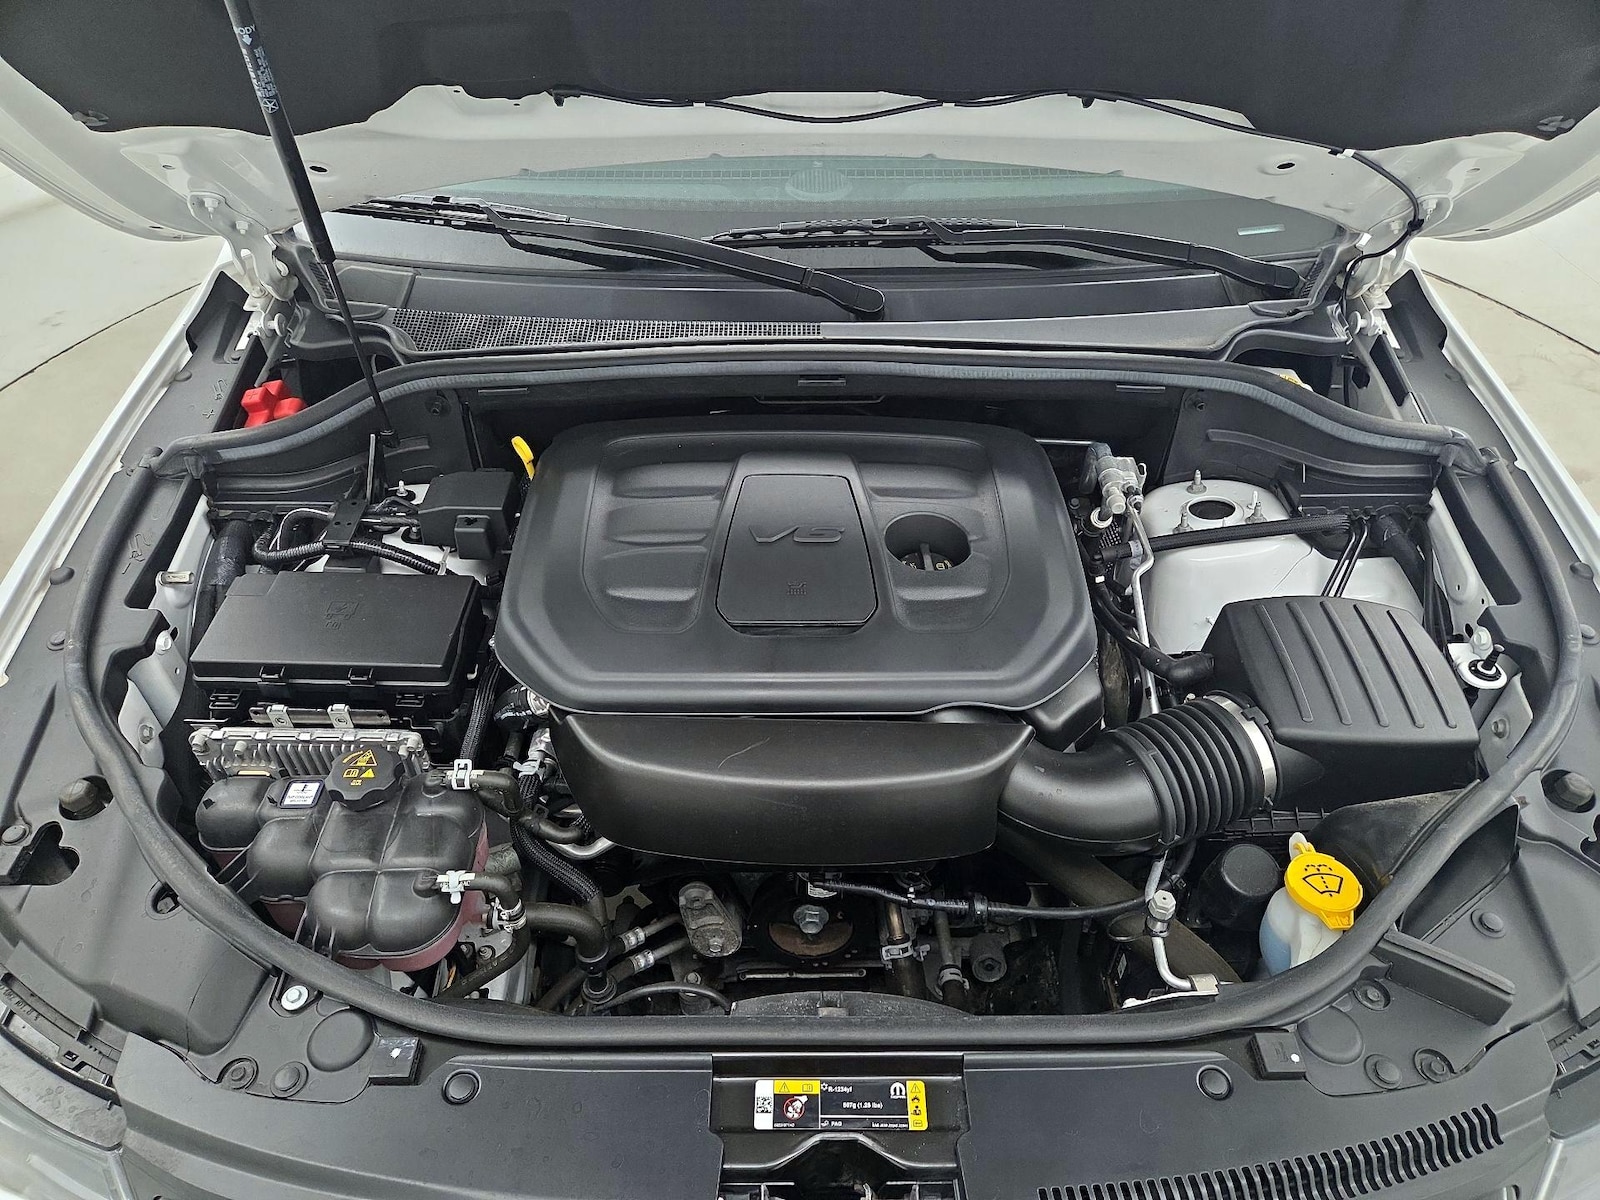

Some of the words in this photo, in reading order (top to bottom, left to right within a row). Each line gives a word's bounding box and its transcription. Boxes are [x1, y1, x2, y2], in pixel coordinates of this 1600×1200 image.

[748, 525, 845, 544] V6
[828, 1086, 853, 1094] R-1234yf
[872, 1101, 884, 1110] lbs)
